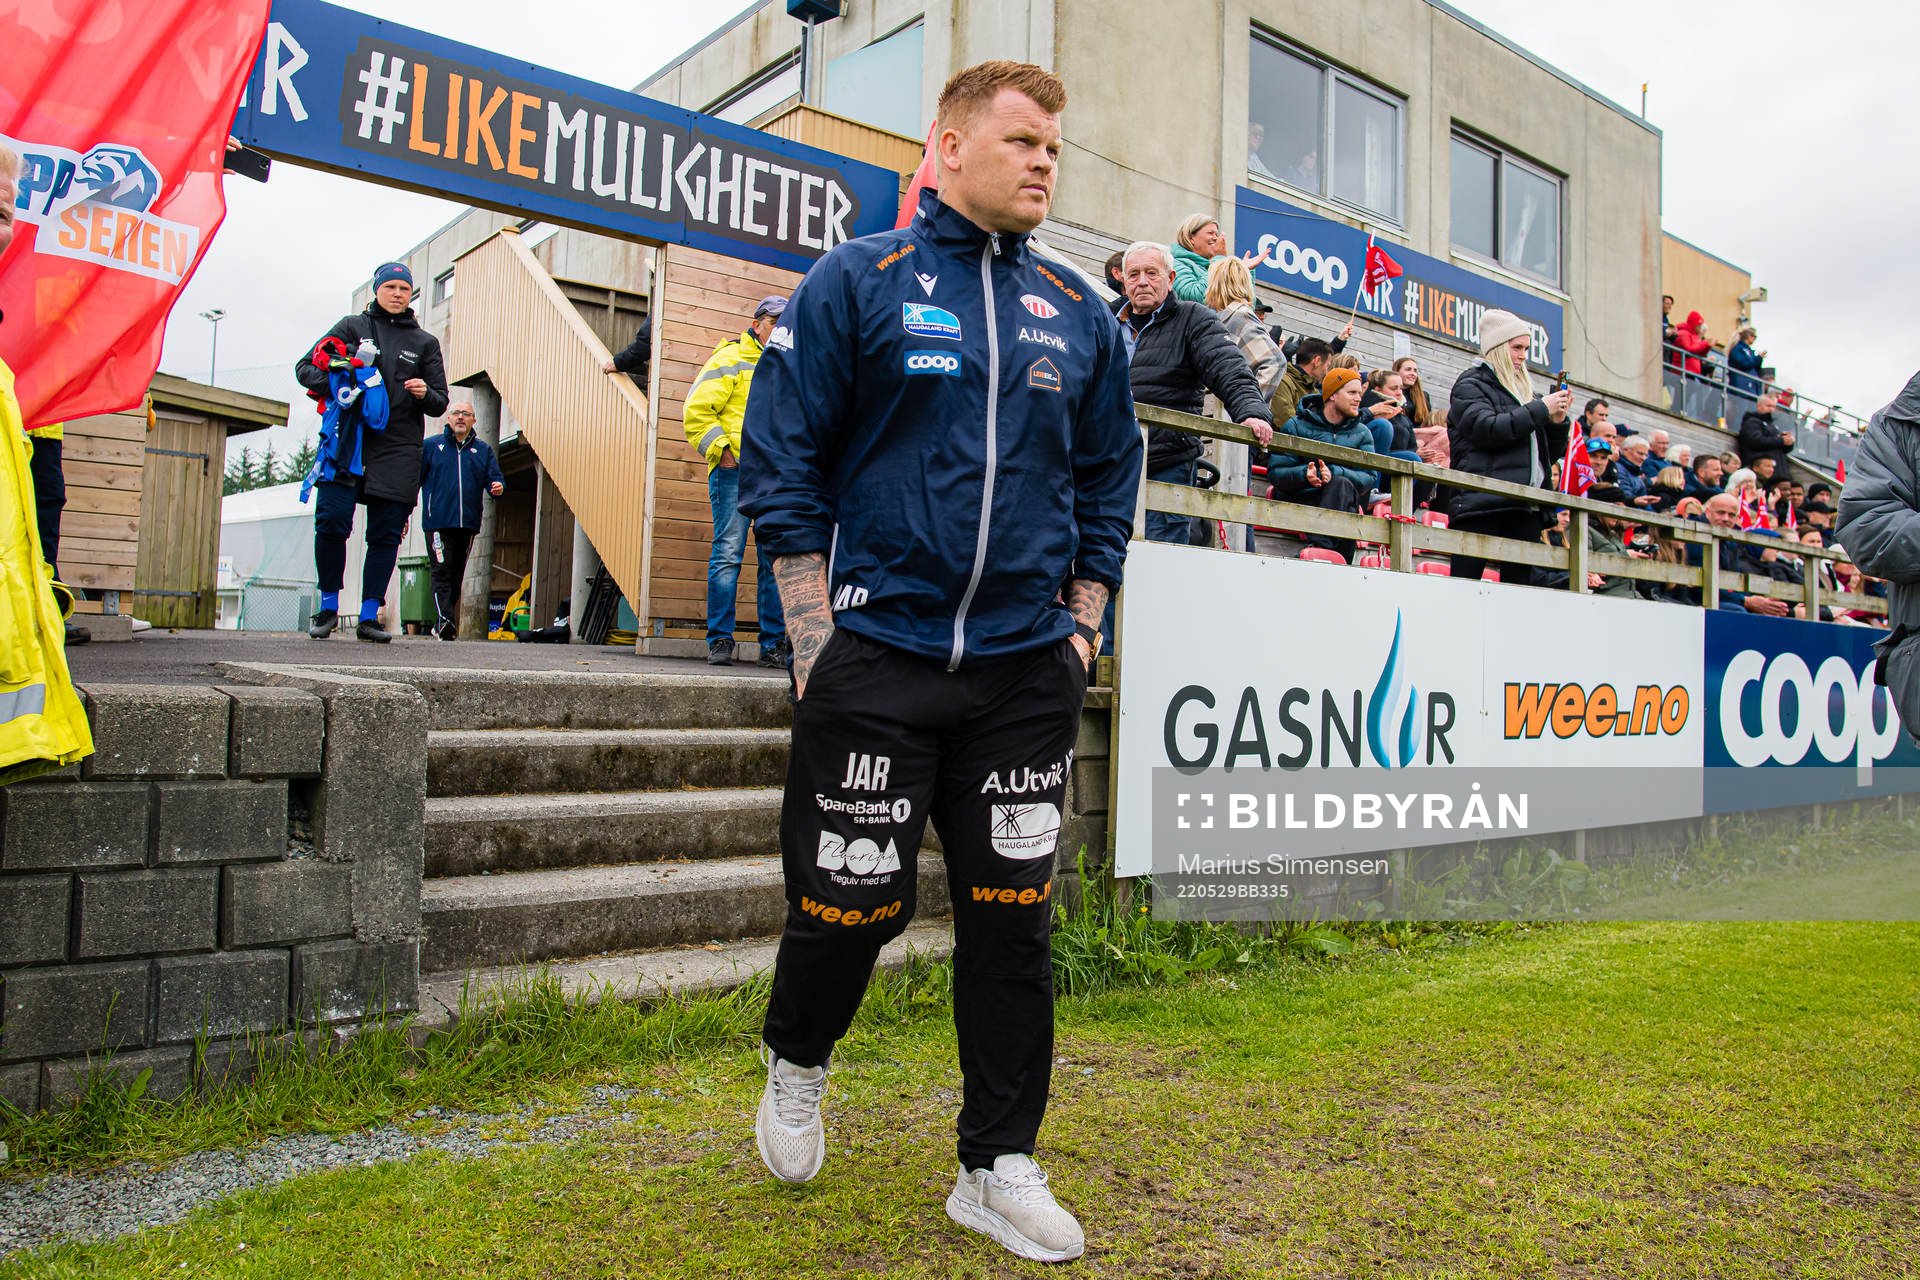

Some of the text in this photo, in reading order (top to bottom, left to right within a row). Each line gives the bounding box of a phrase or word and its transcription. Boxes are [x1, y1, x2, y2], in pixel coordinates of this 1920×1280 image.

[353, 51, 852, 250] #LIKEMULIGHETER
[876, 244, 916, 271] wee.no
[1257, 233, 1349, 295] coop
[1036, 264, 1083, 302] wee.no
[1019, 327, 1067, 352] A.Utvik
[907, 355, 959, 372] coop
[1503, 682, 1690, 740] wee.no
[1720, 649, 1901, 787] coop
[841, 752, 891, 791] JAR
[980, 762, 1063, 794] A.Utvik
[815, 793, 890, 814] SpareBank
[853, 816, 891, 824] SR-BANK
[998, 838, 1043, 849] HAUGALAND
[830, 871, 891, 886] Tregulv med stil
[801, 895, 901, 926] wee.no
